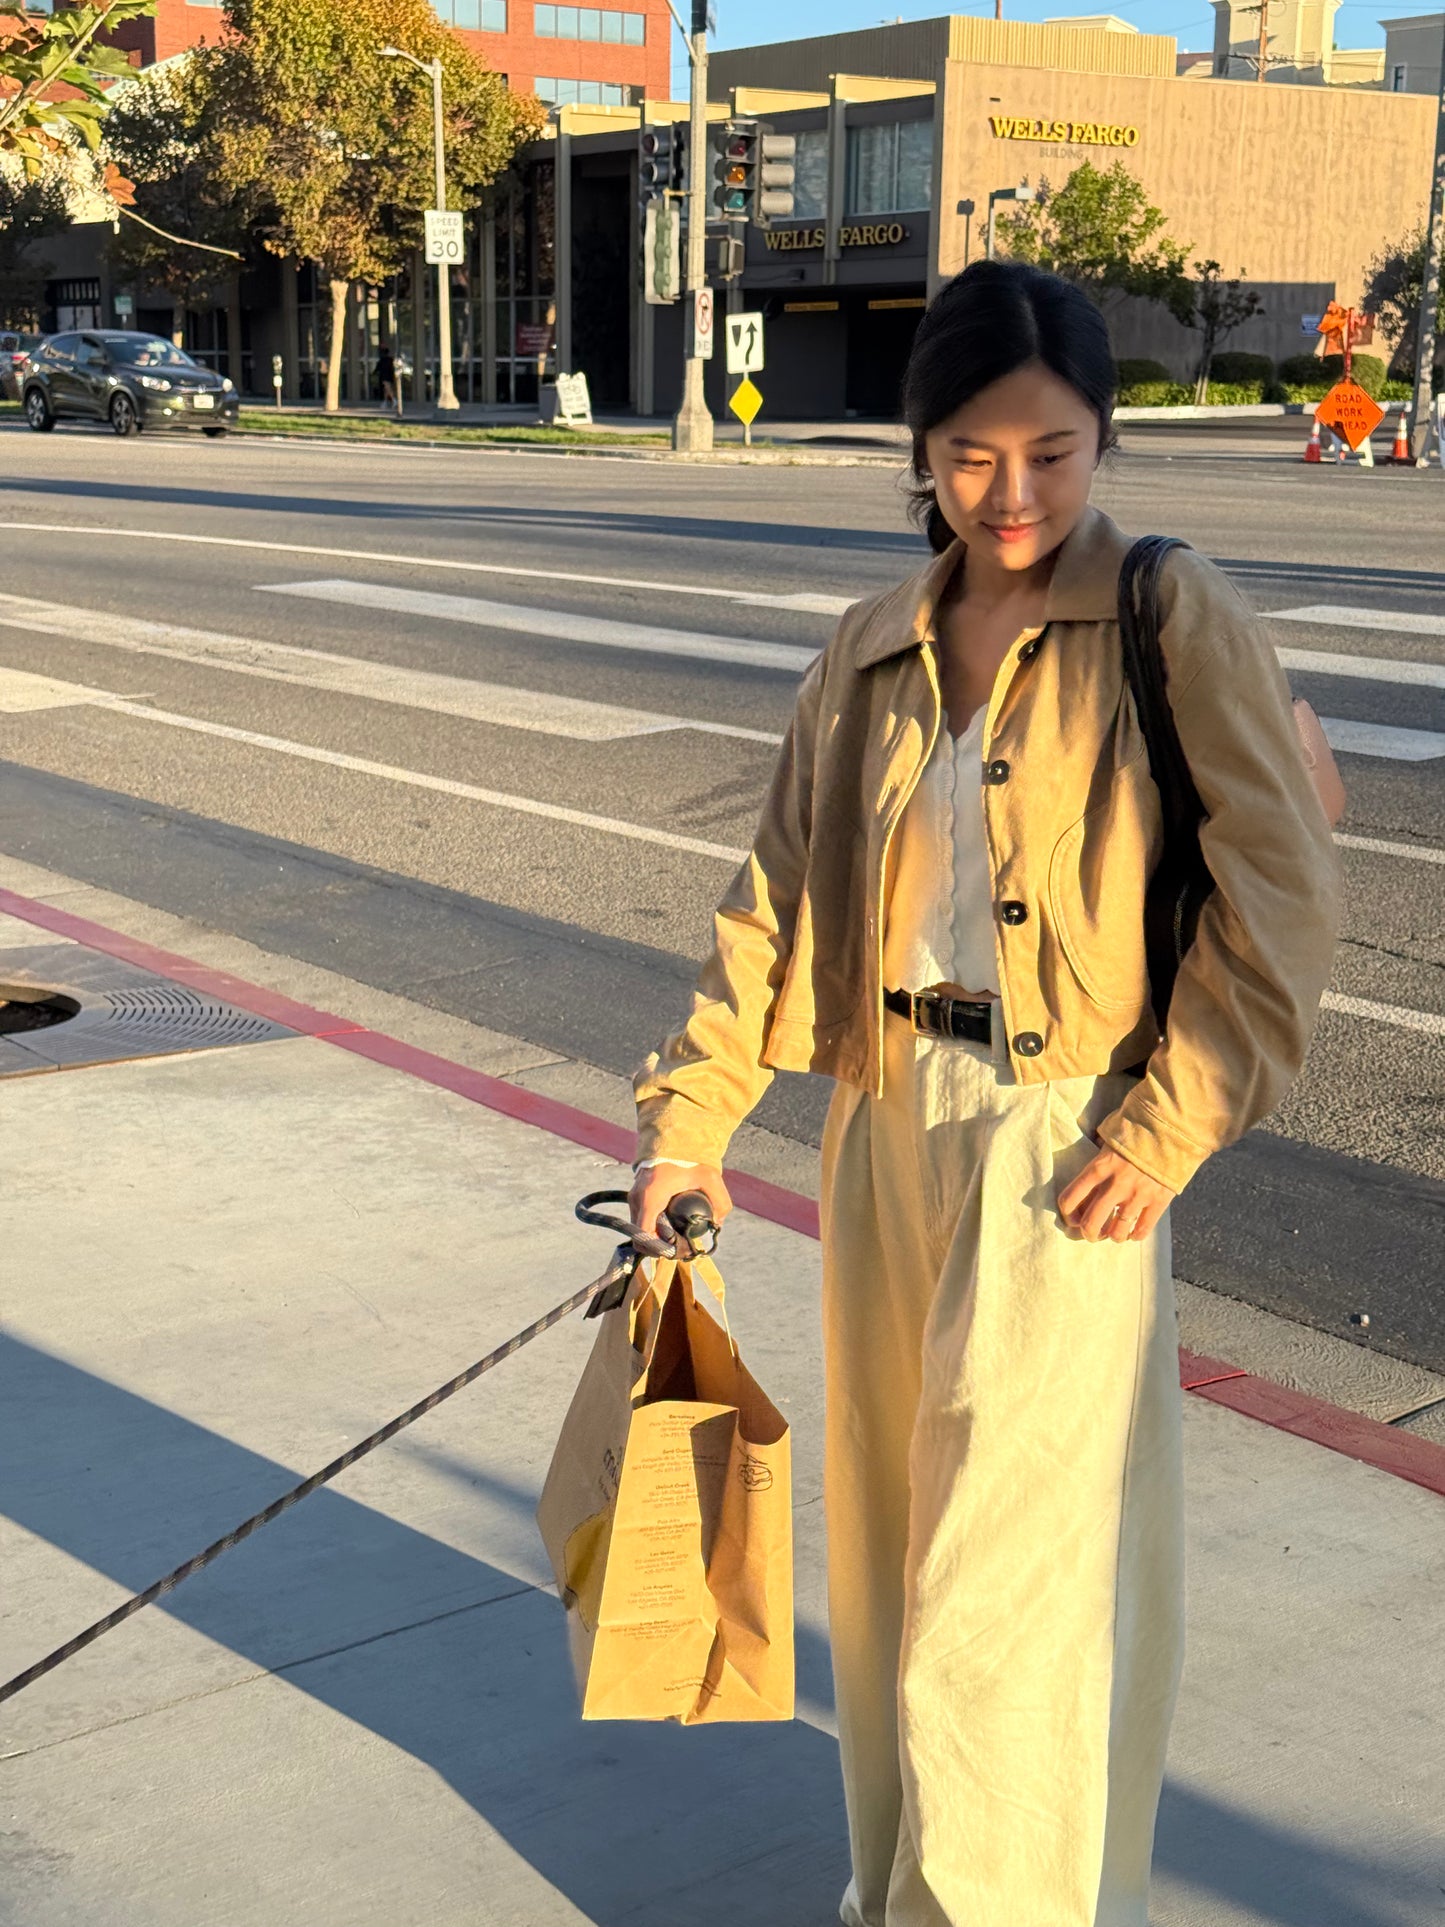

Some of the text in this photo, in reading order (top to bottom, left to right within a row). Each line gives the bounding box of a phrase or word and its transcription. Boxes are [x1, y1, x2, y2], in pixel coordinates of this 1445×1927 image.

[989, 117, 1140, 147] WELLS FARGO
[764, 223, 903, 250] WELLS FARGO
[432, 241, 459, 257] 30
[1335, 394, 1362, 403] ROAD
[1336, 408, 1363, 417] WORK
